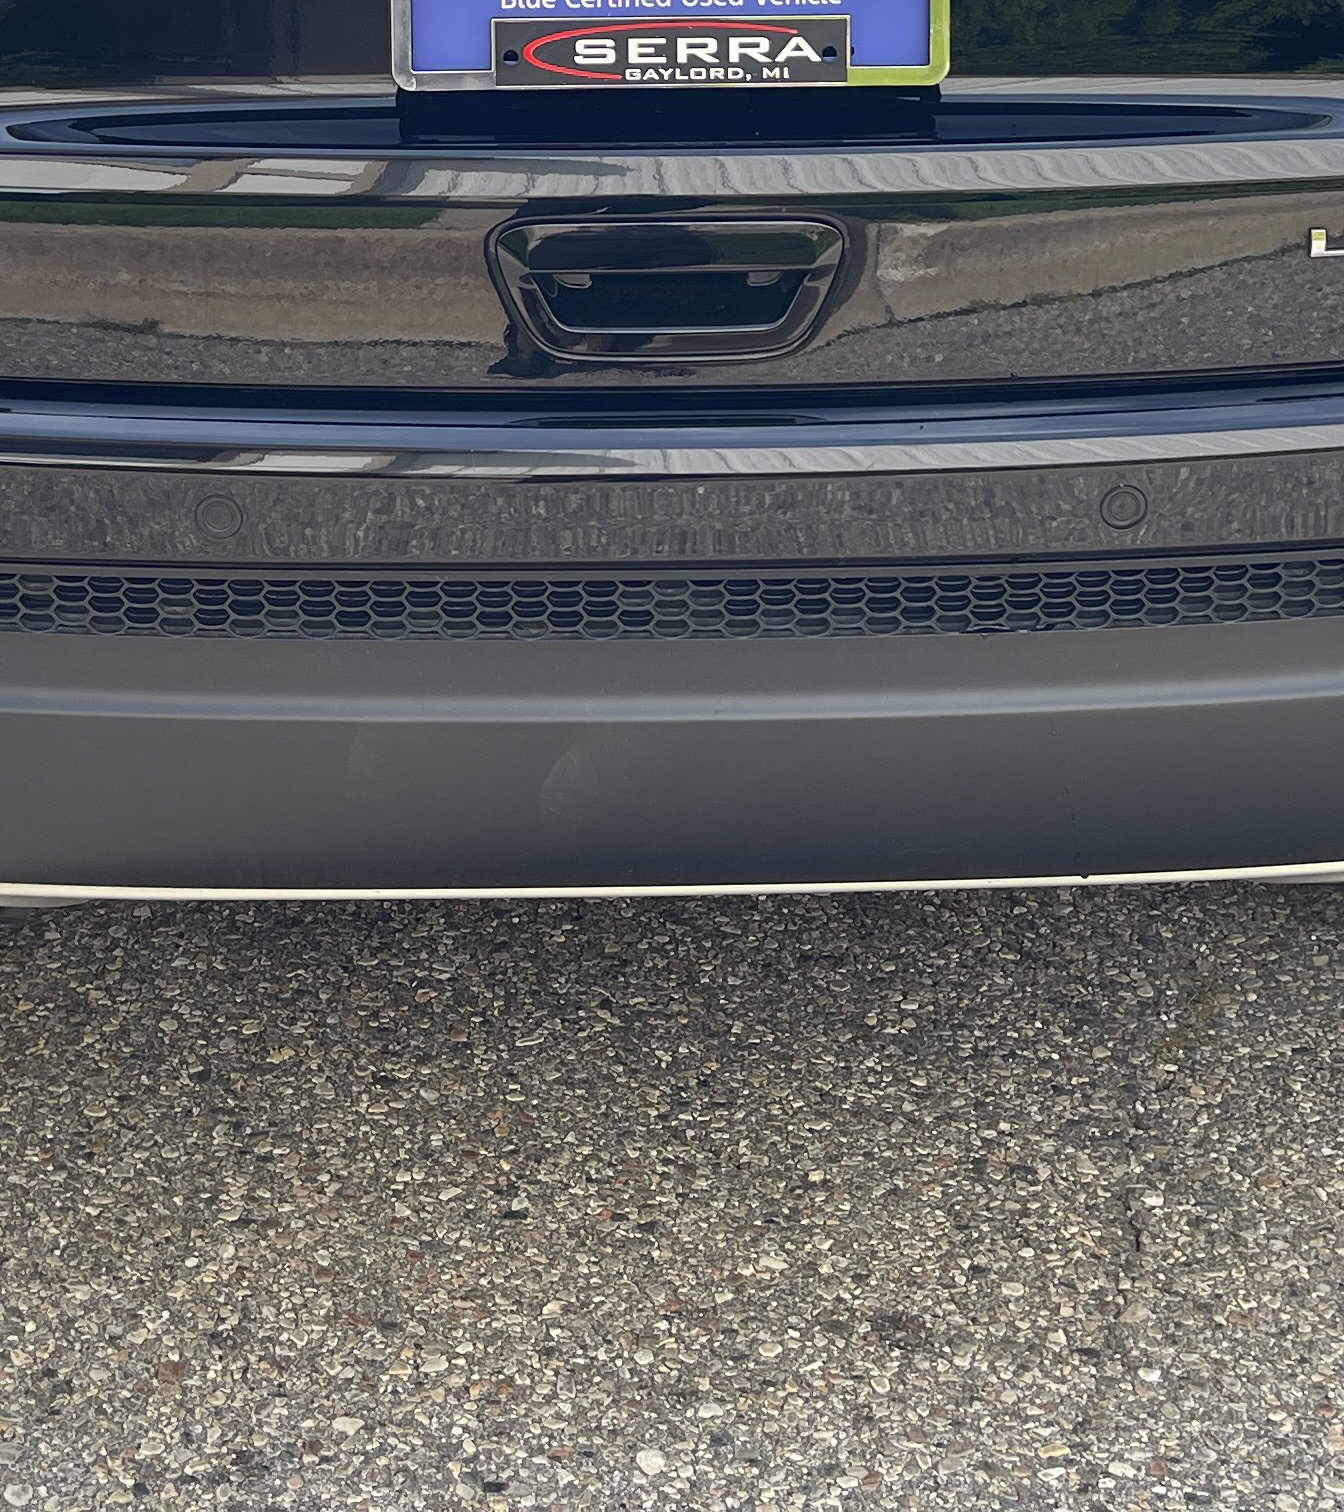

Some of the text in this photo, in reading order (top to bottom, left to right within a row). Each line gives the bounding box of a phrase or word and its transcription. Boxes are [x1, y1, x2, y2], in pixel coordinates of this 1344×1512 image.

[573, 36, 822, 65] SERRA
[624, 66, 790, 82] GAYLORD, MI
